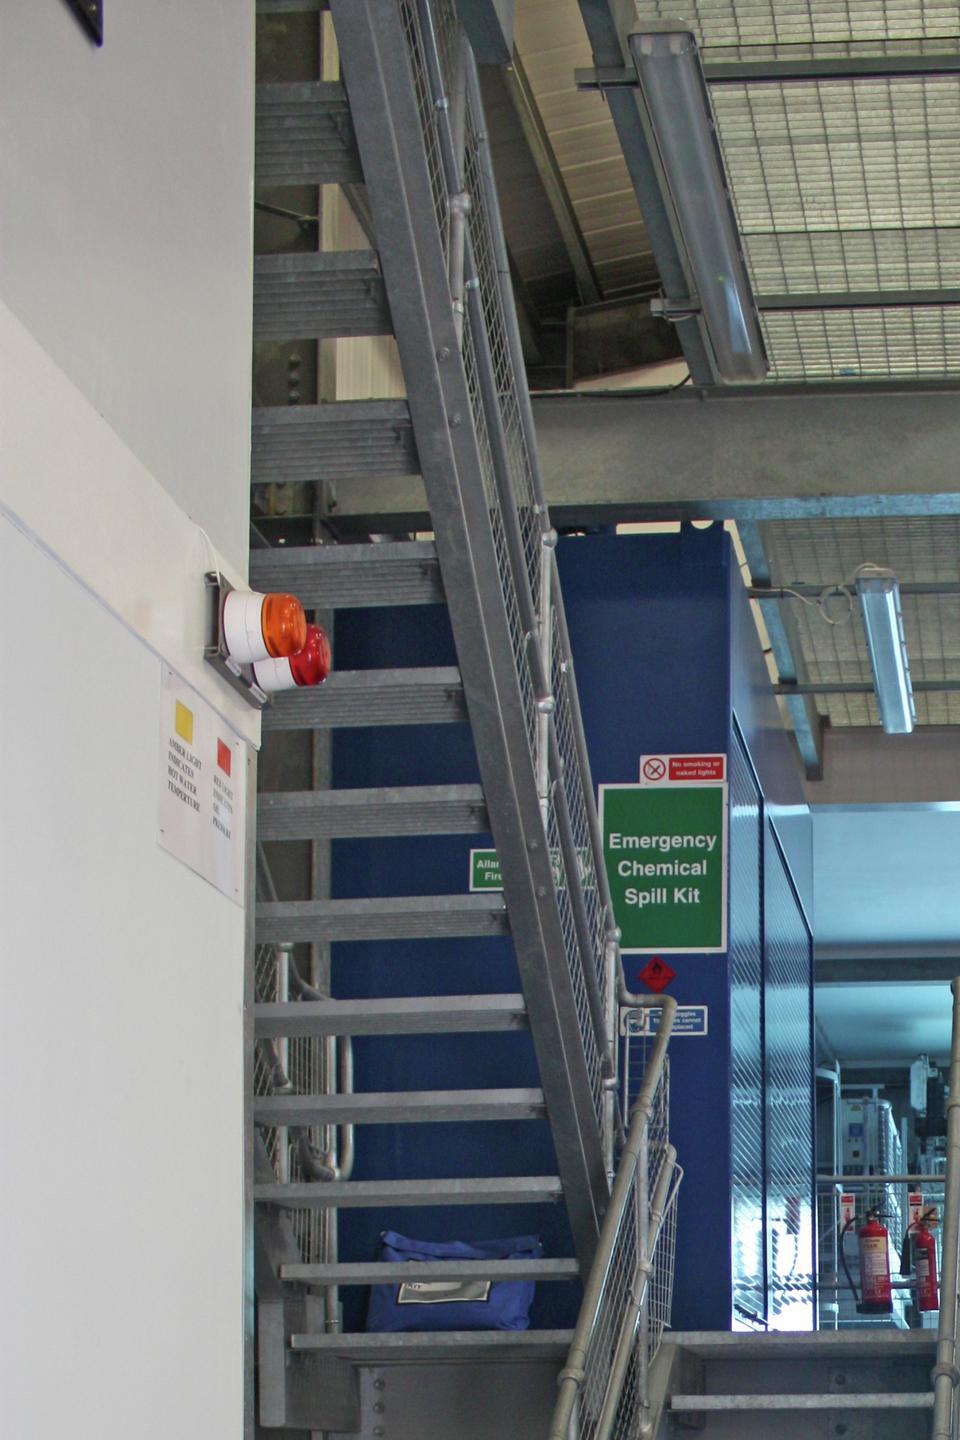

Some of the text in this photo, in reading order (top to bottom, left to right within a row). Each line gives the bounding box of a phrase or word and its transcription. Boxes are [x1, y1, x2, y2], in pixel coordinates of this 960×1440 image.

[169, 737, 202, 770] AMBER LIGHT
[168, 751, 194, 778] INDICATES
[684, 760, 711, 769] smoking
[697, 769, 716, 777] lights
[168, 765, 197, 796] HOT WATER
[608, 832, 717, 852] Emergency
[617, 859, 707, 877] Chemical
[625, 887, 700, 909] Spill Kit
